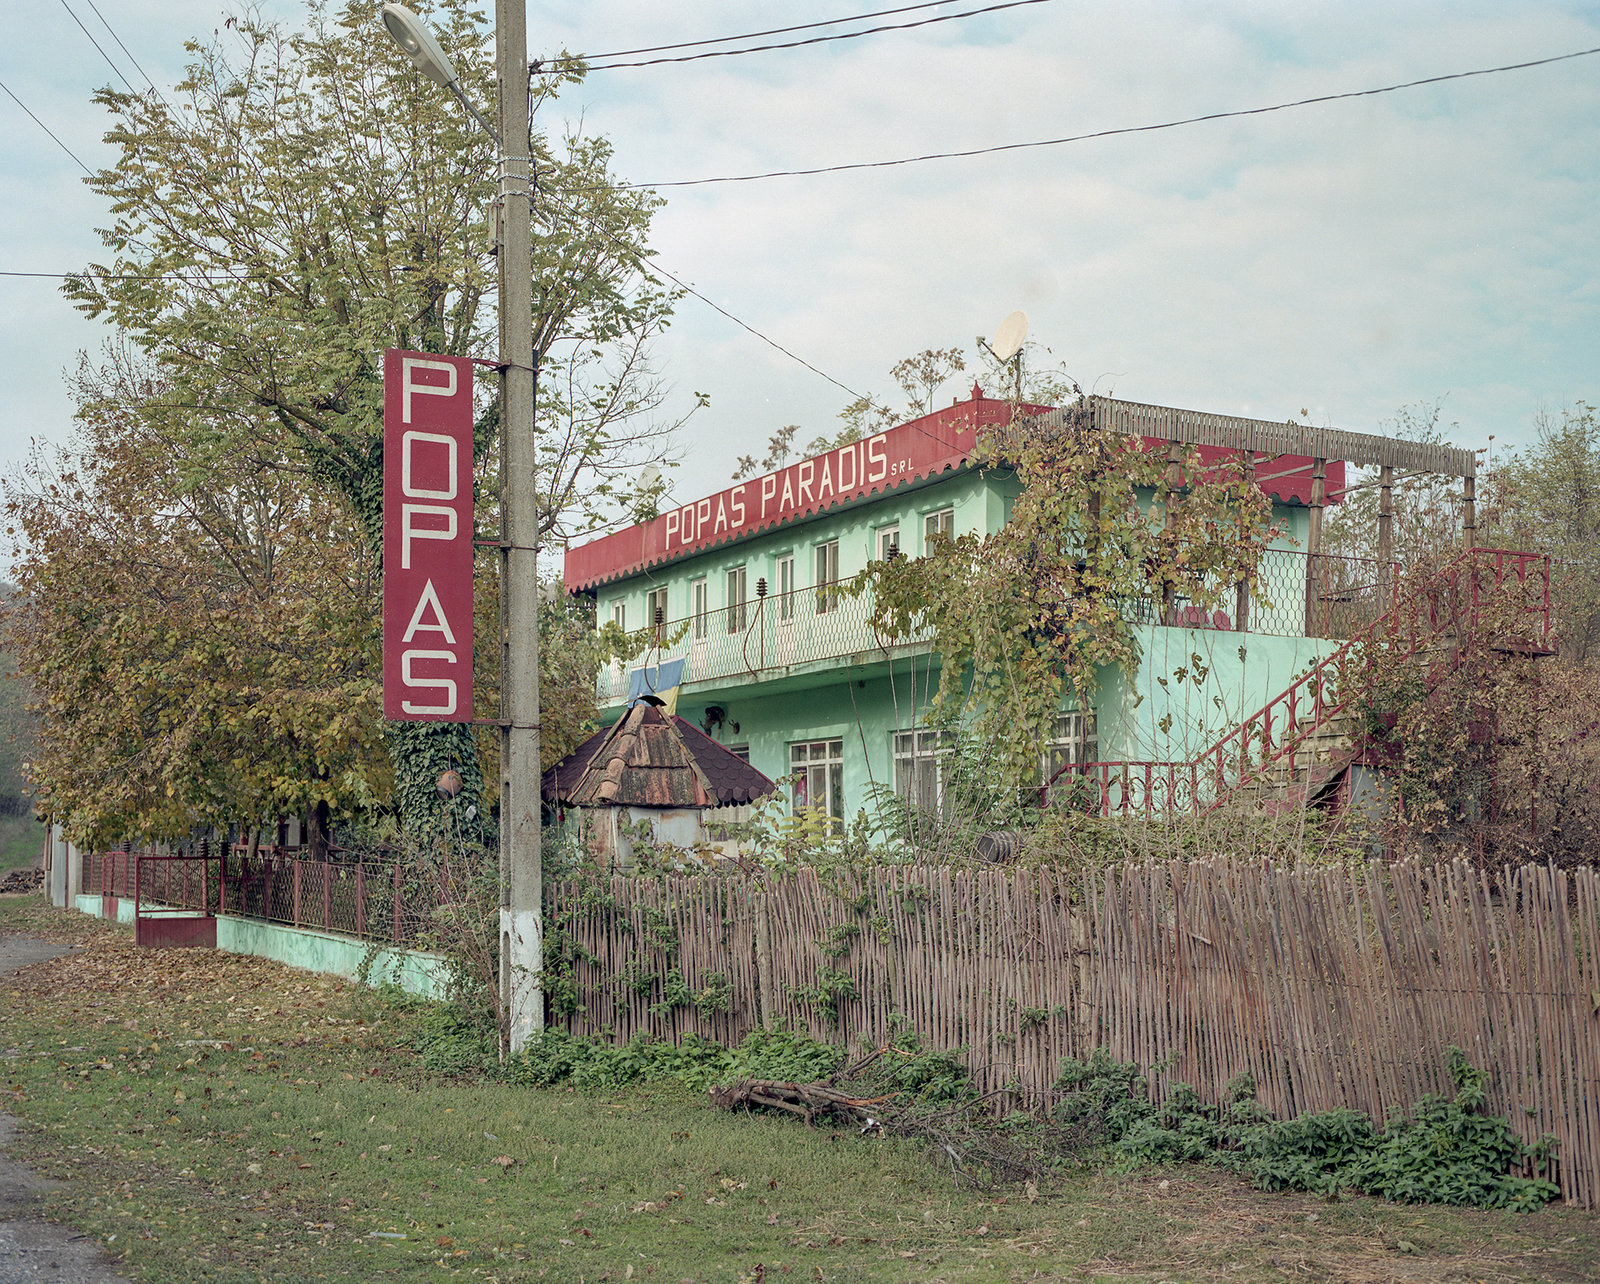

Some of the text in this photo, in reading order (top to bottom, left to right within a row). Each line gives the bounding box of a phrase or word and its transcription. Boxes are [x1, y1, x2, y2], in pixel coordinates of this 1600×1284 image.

[401, 357, 458, 715] POPAS
[665, 433, 914, 551] POPAS PARADIS SRL
